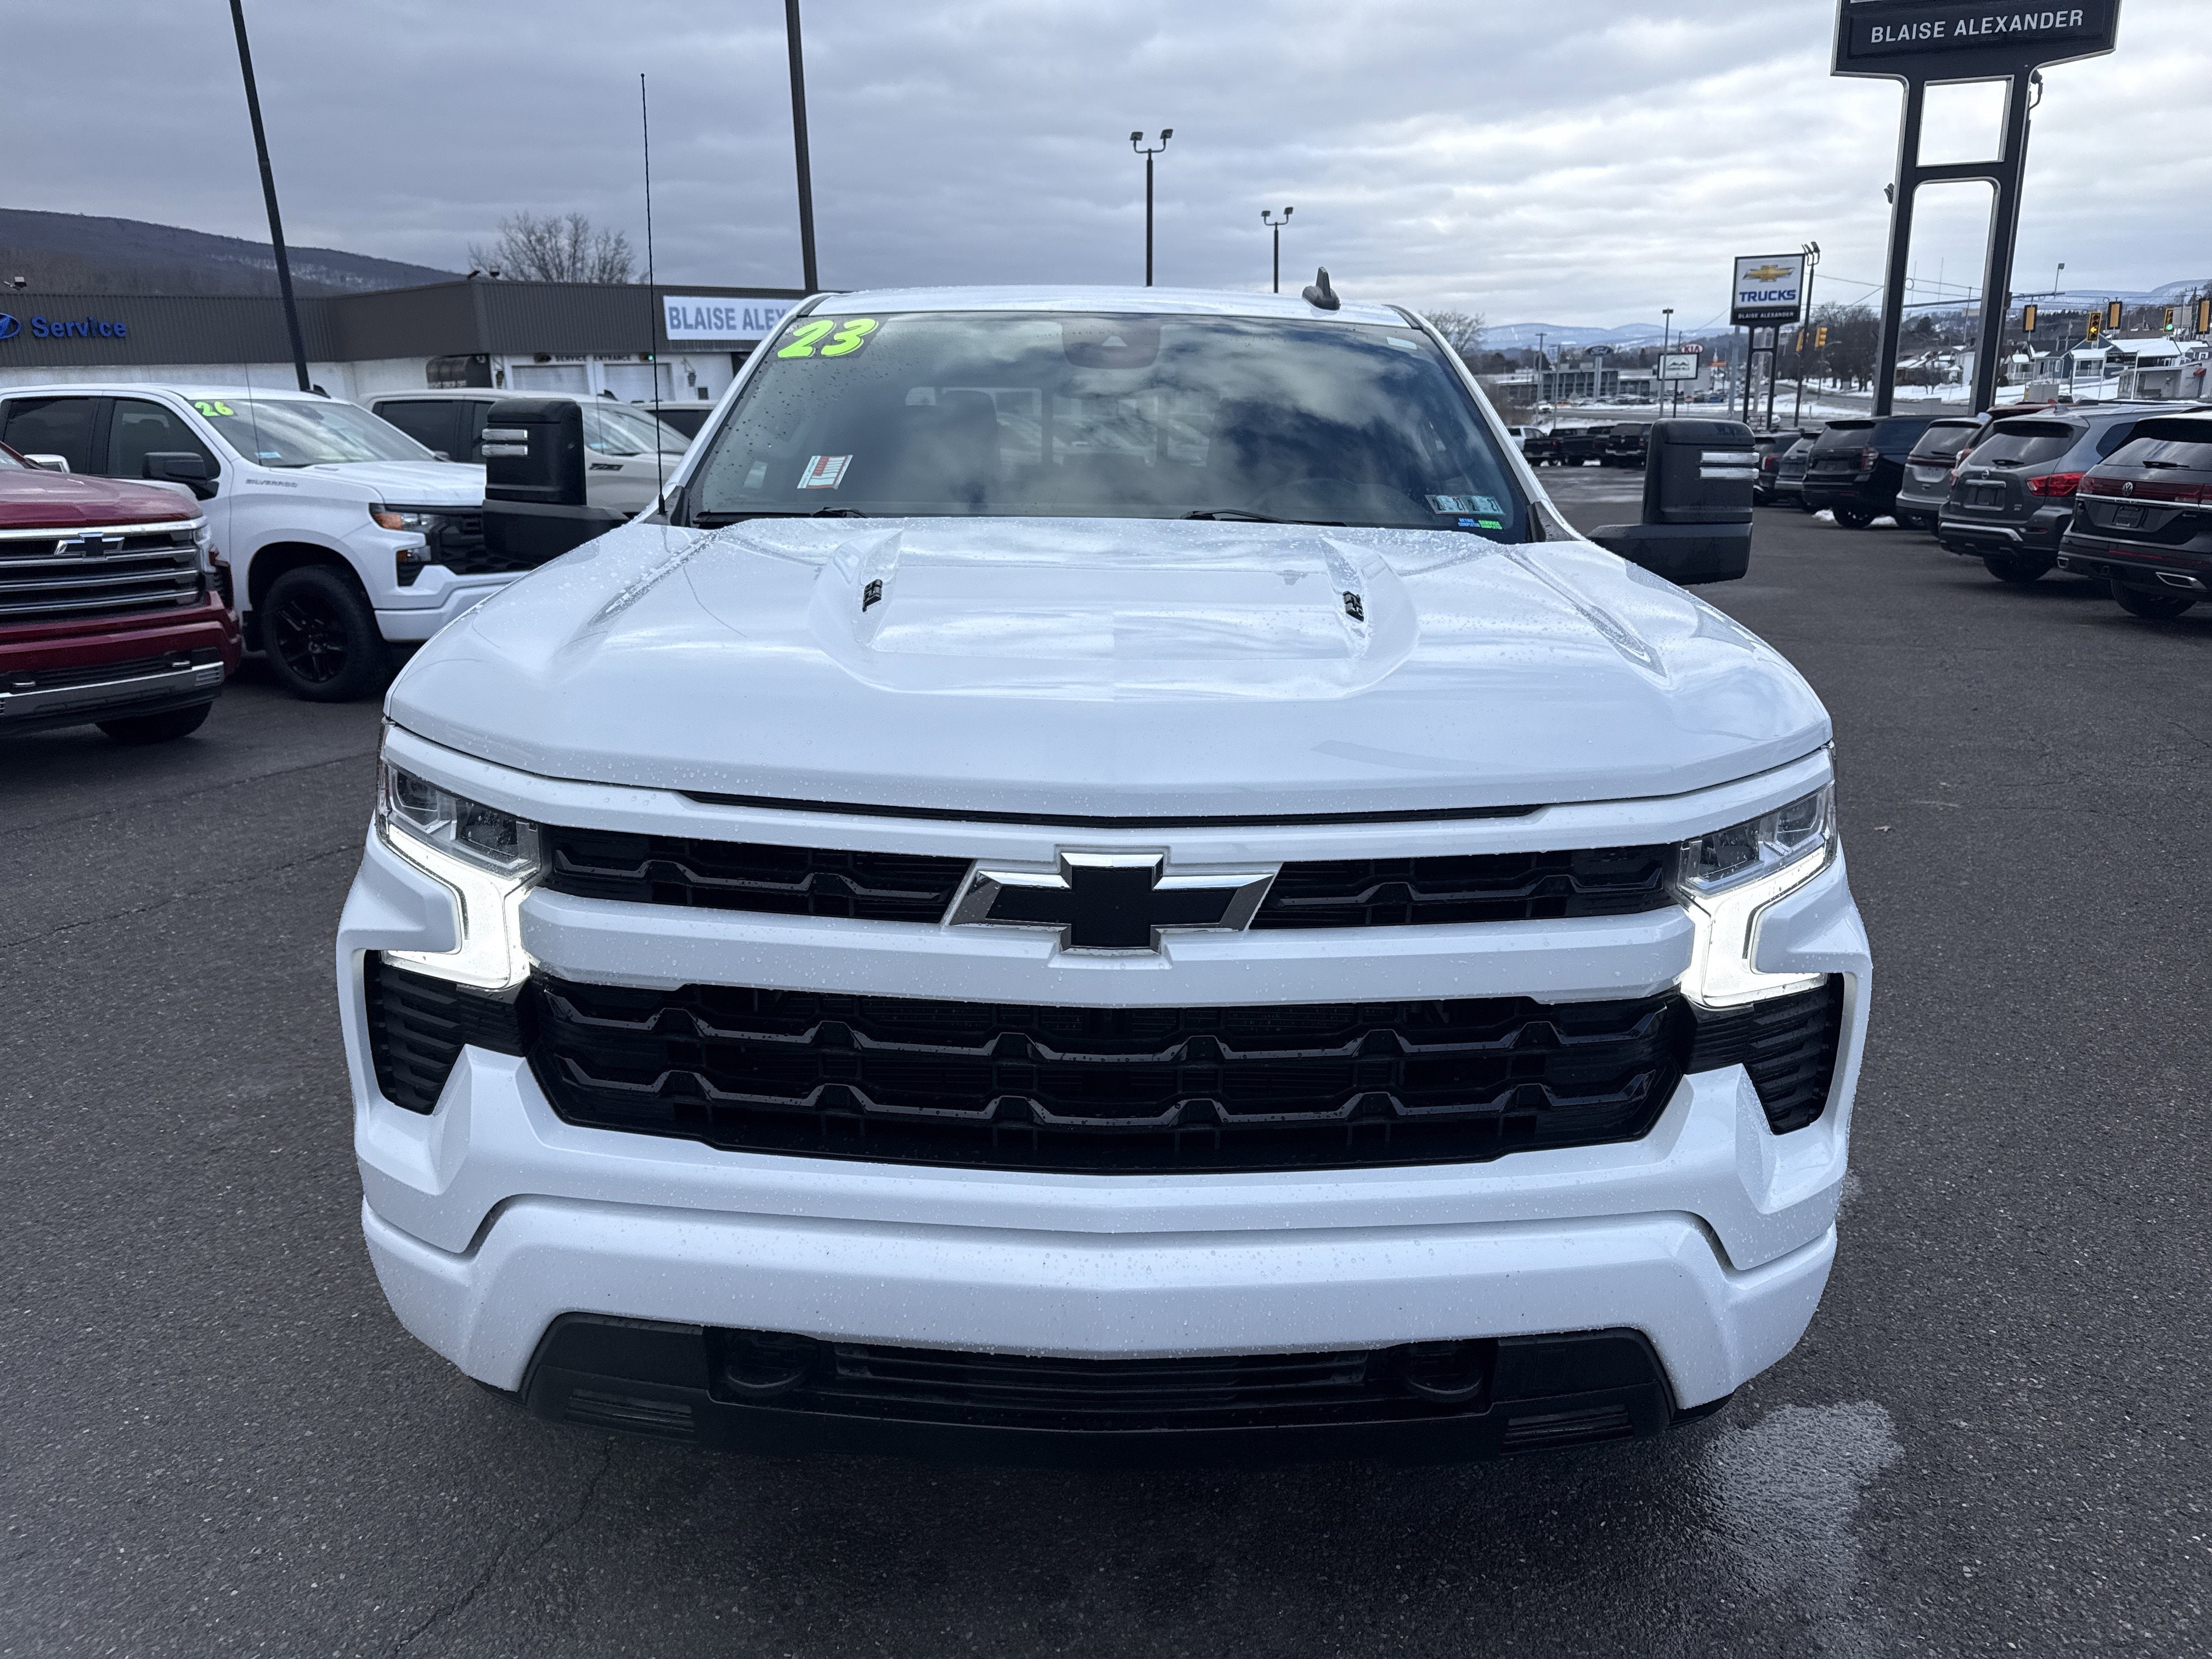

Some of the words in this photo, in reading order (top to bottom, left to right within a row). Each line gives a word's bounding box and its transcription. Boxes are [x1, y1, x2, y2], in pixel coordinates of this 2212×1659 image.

[1871, 21, 1945, 43] BLAISE
[1954, 9, 2083, 37] ALEXANDER
[1739, 289, 1796, 302] TRUCKS
[31, 315, 127, 338] Service
[668, 306, 737, 330] BLAISE
[777, 318, 879, 359] 23
[195, 401, 234, 417] 26
[246, 478, 298, 488] SILVERADO
